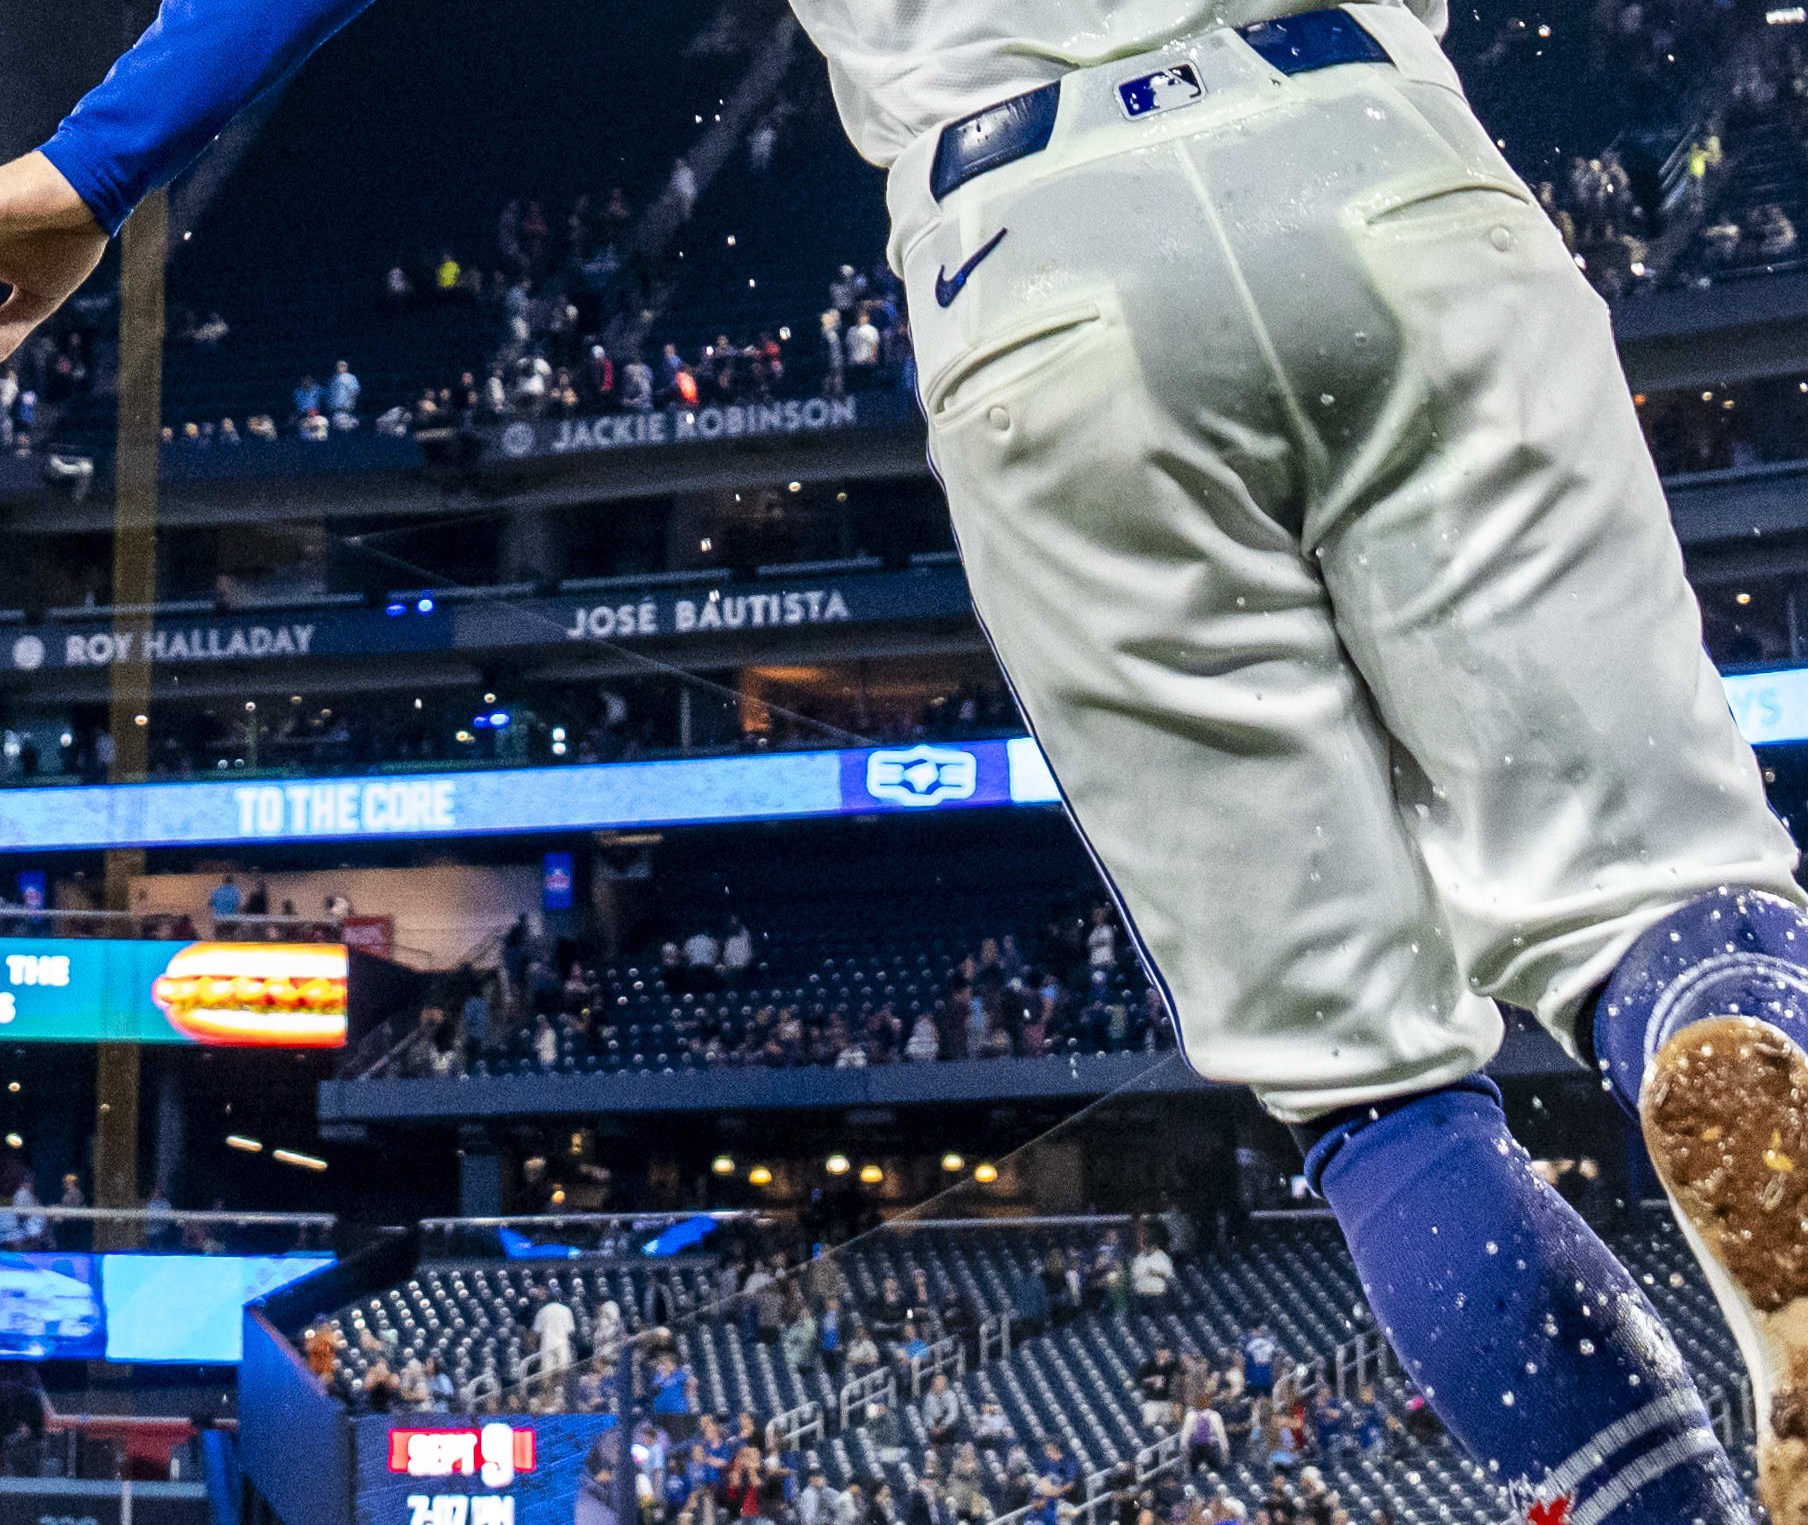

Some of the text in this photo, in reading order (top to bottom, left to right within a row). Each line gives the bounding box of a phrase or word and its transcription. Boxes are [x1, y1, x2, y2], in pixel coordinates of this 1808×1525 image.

[552, 398, 858, 450] JACKIE ROBINSON
[567, 590, 849, 639] JOSÉ BAUTISTA
[65, 625, 316, 666] ROY HALLADAY
[234, 780, 457, 835] TO THE CORE
[6, 954, 70, 986] THE
[407, 1423, 514, 1488] SEPT 9
